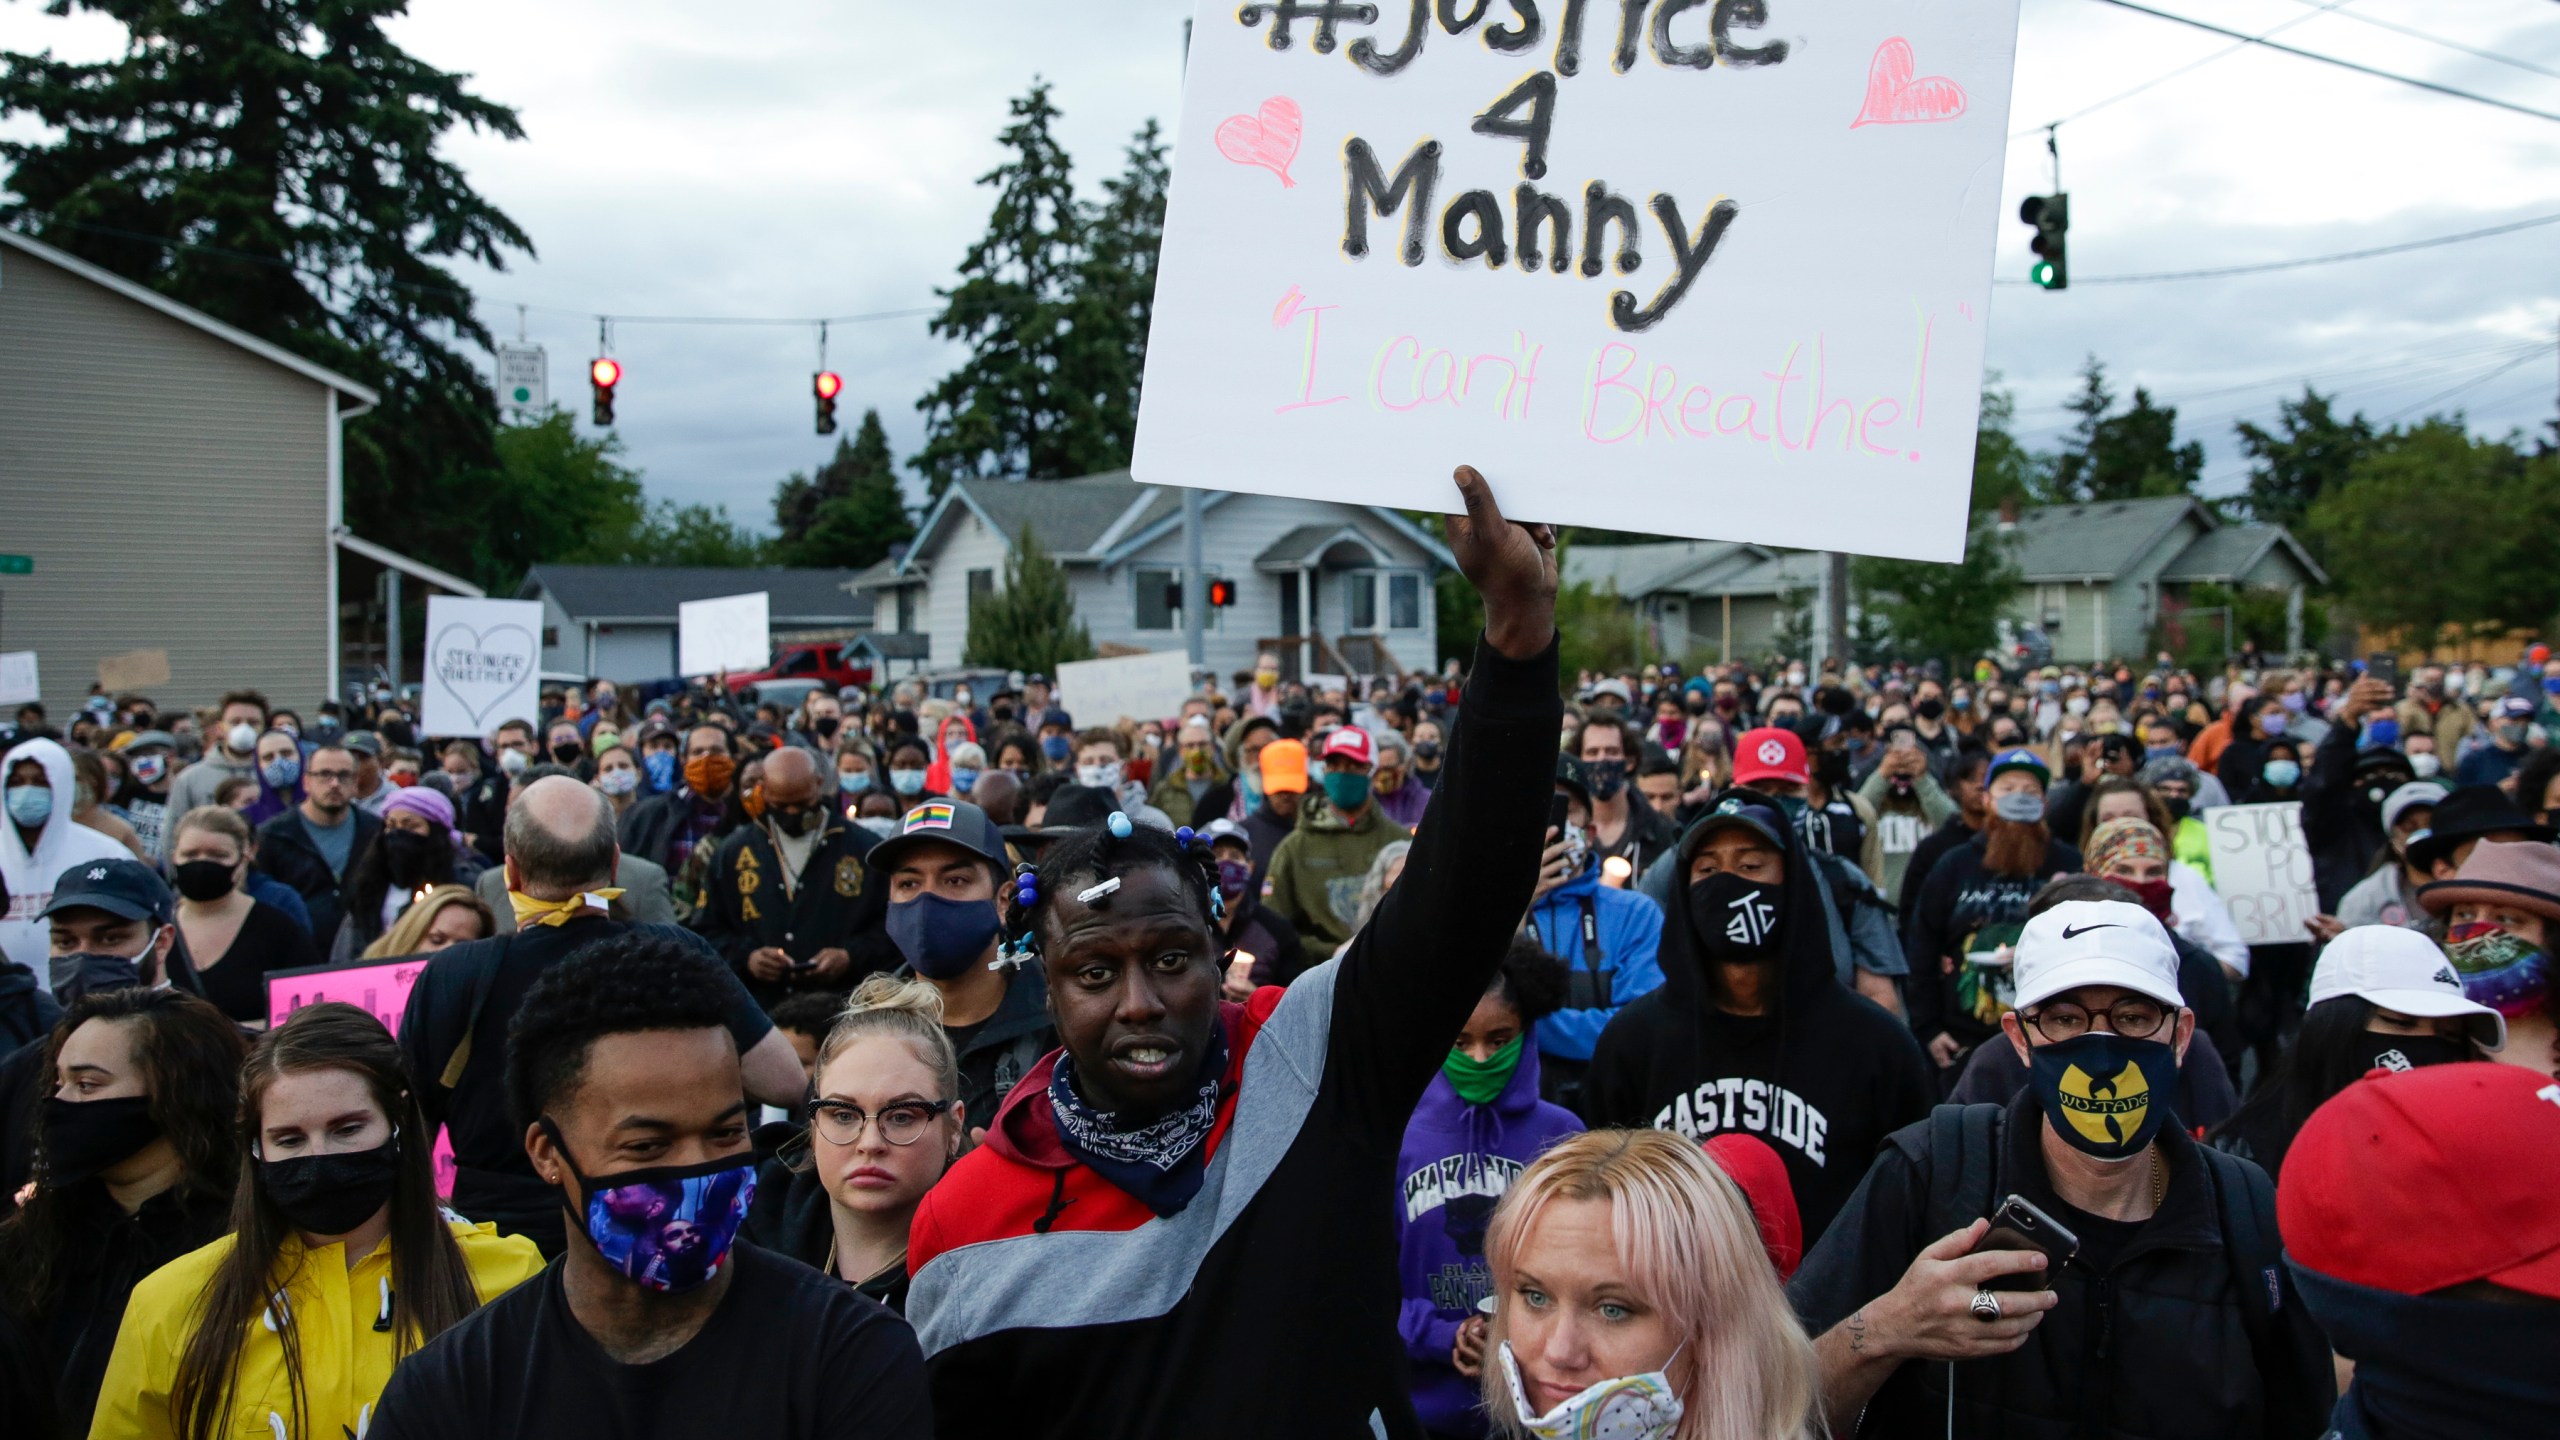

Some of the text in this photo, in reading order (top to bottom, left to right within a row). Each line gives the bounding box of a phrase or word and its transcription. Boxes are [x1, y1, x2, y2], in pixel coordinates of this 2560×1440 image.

[1472, 70, 1558, 180] 4
[1341, 135, 1740, 333] Manny
[2059, 1092, 2149, 1112] WU-TANG
